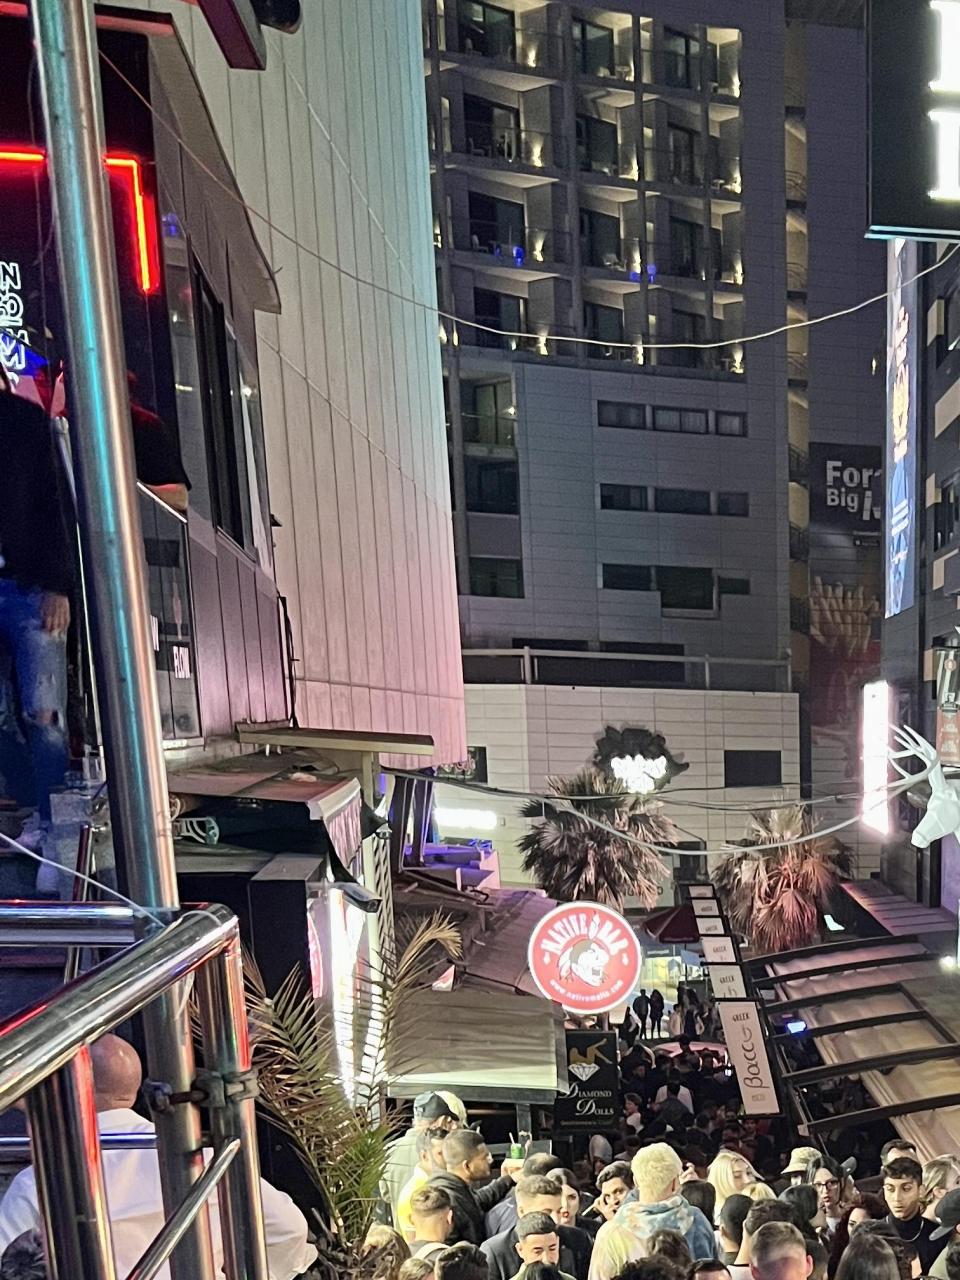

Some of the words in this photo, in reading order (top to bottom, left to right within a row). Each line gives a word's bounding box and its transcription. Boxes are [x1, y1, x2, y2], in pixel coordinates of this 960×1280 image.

[826, 487, 859, 513] Big
[540, 912, 588, 956] NATIVE
[597, 919, 629, 956] BAR
